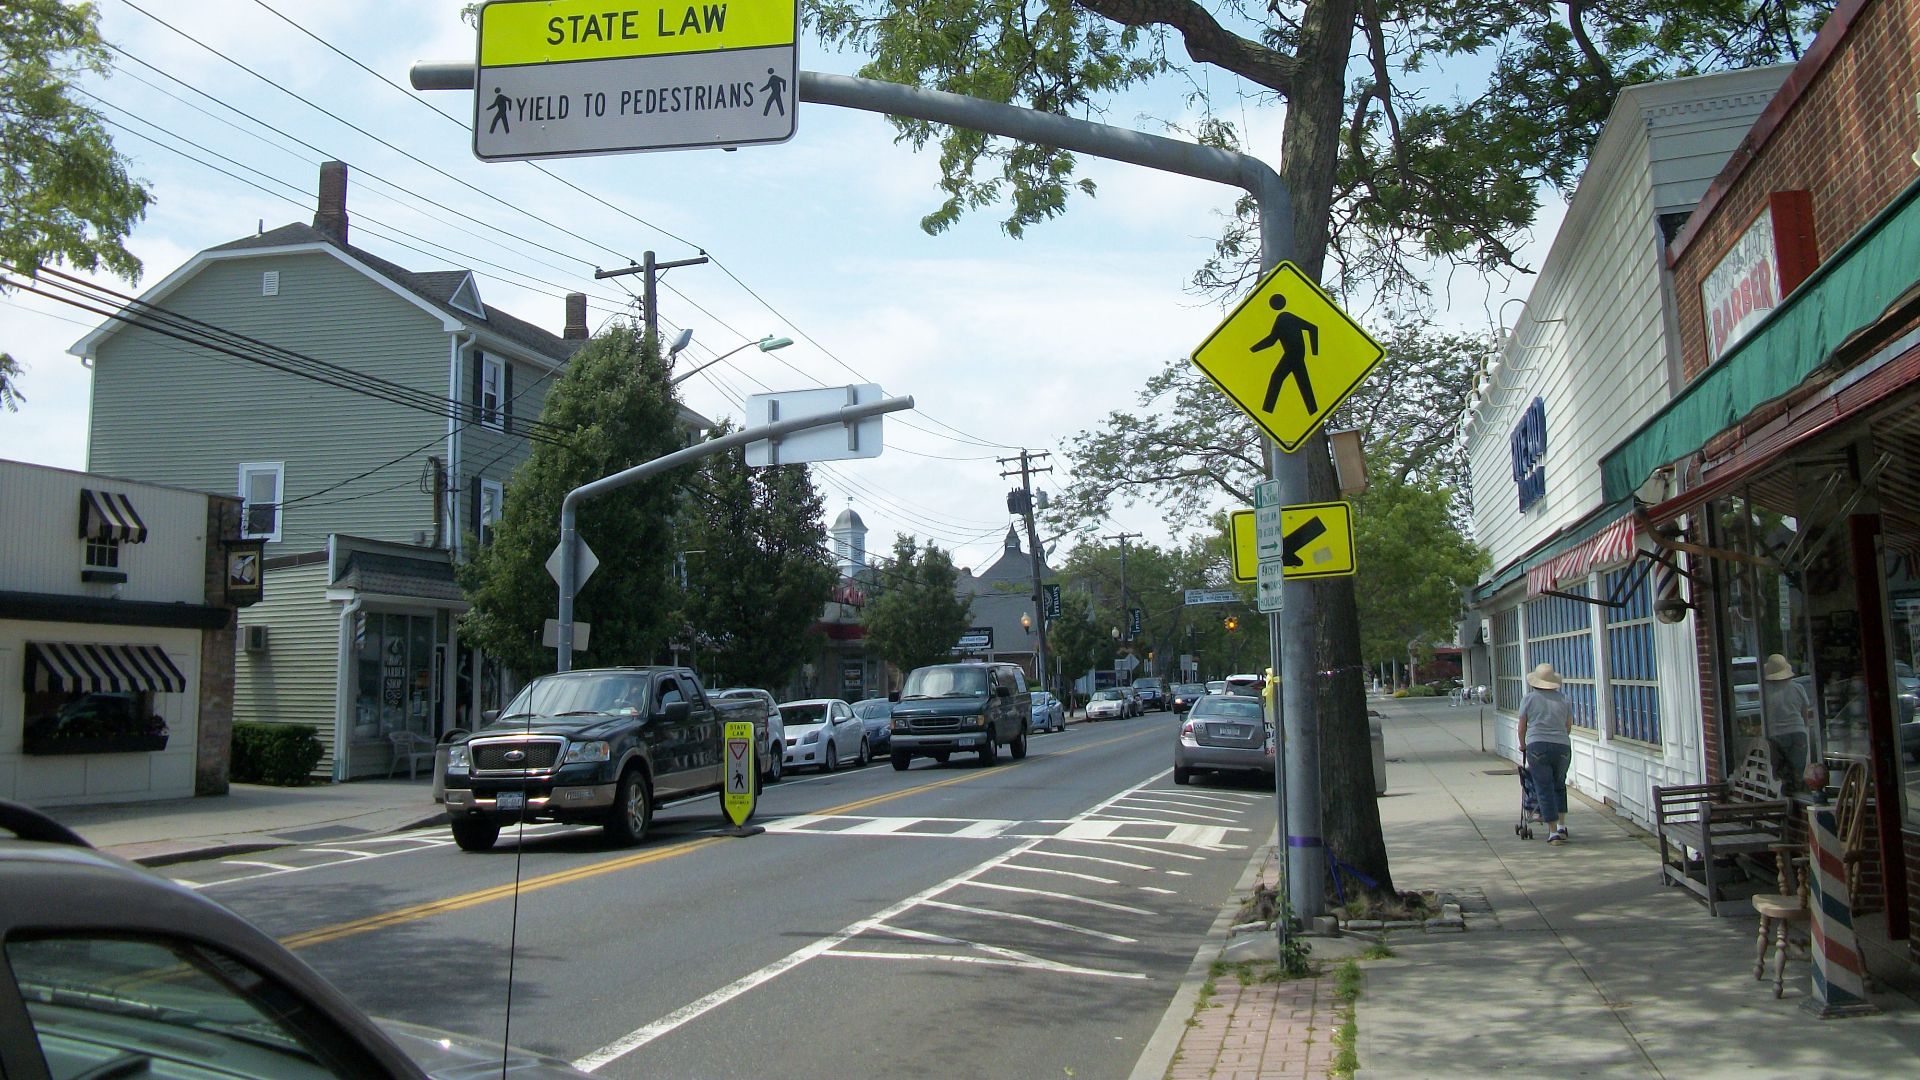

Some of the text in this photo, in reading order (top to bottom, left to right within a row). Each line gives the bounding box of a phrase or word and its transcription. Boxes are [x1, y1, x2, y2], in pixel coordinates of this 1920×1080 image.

[546, 3, 728, 46] STATE LAW
[515, 81, 755, 122] YIELD TO PEDESTRIANS
[1712, 258, 1774, 357] BARBER
[1261, 563, 1280, 577] EXCEPT
[1260, 579, 1281, 592] SNDAYS
[1261, 595, 1282, 607] HOLIDAYS
